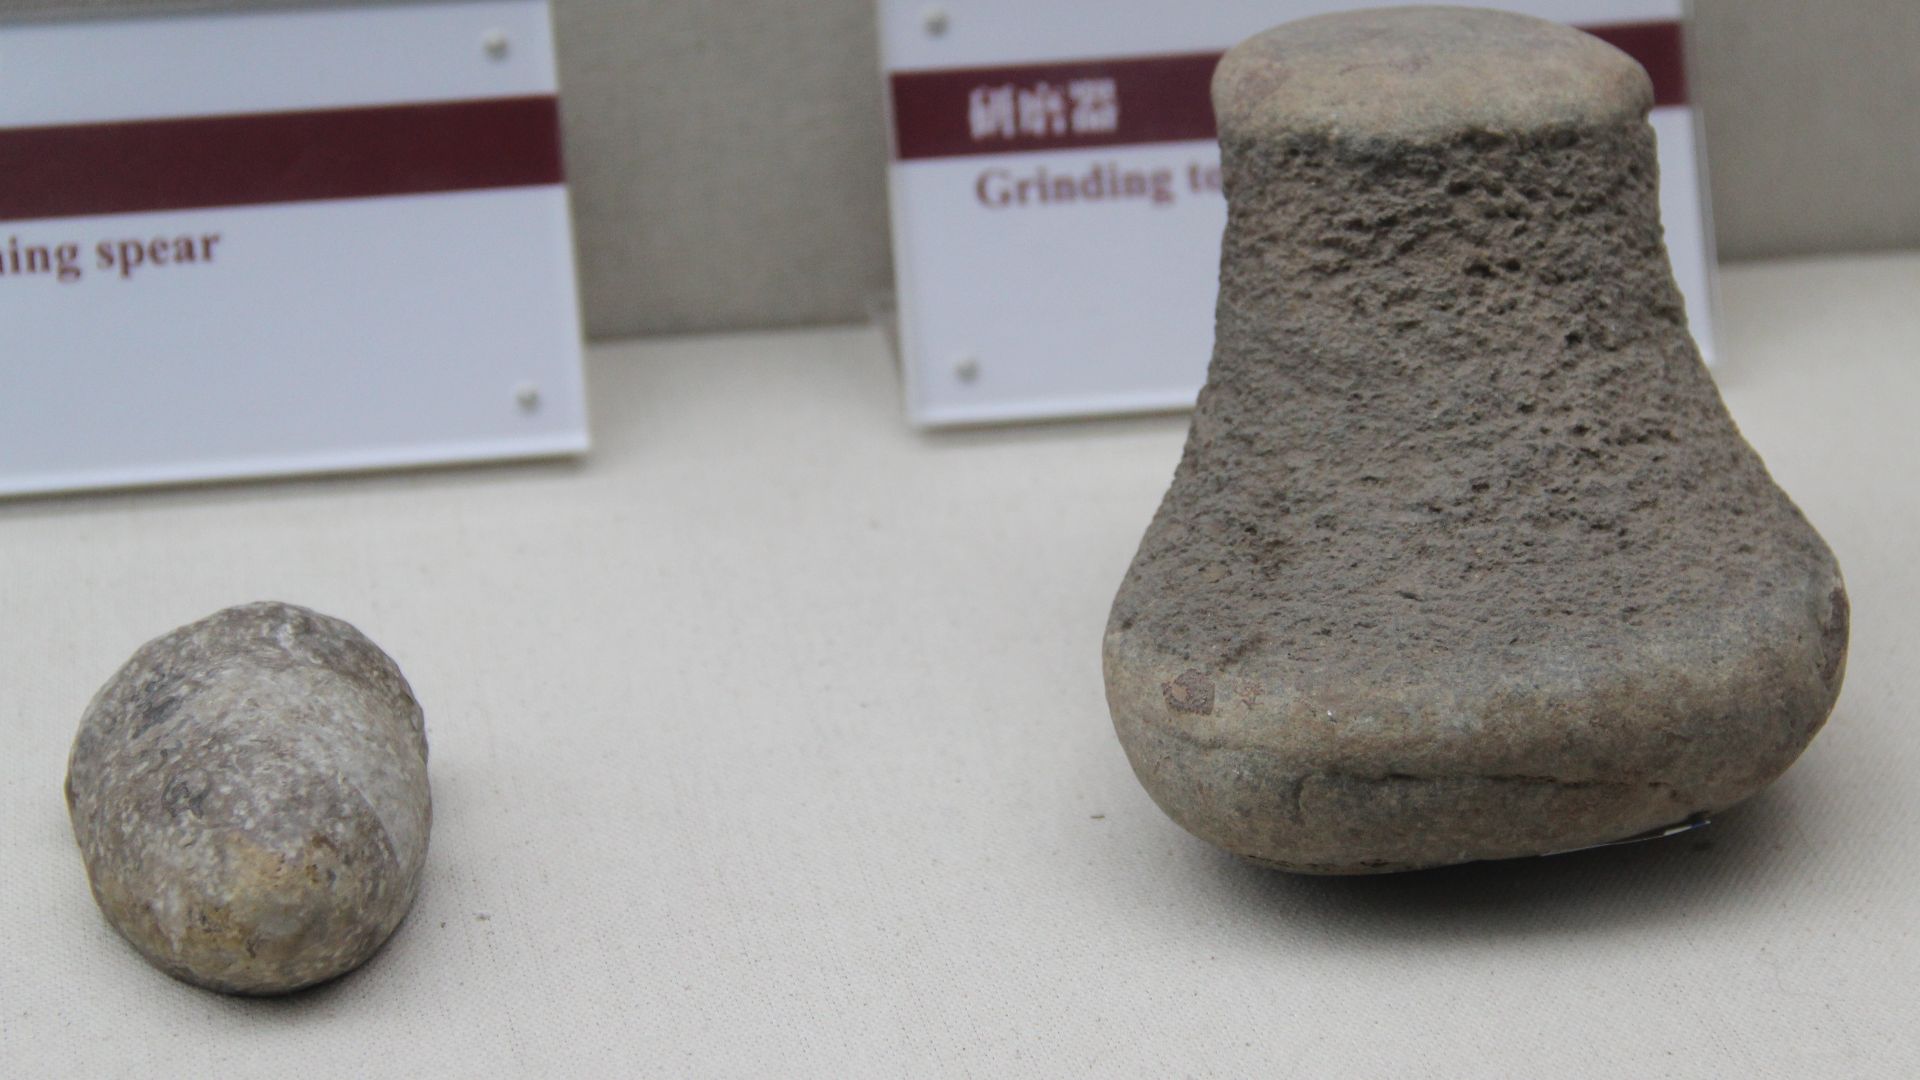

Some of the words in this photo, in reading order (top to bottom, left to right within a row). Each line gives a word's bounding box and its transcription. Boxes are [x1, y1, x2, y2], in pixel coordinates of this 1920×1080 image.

[976, 163, 1175, 207] Grinding
[0, 235, 82, 282] ing
[95, 232, 220, 278] spear
